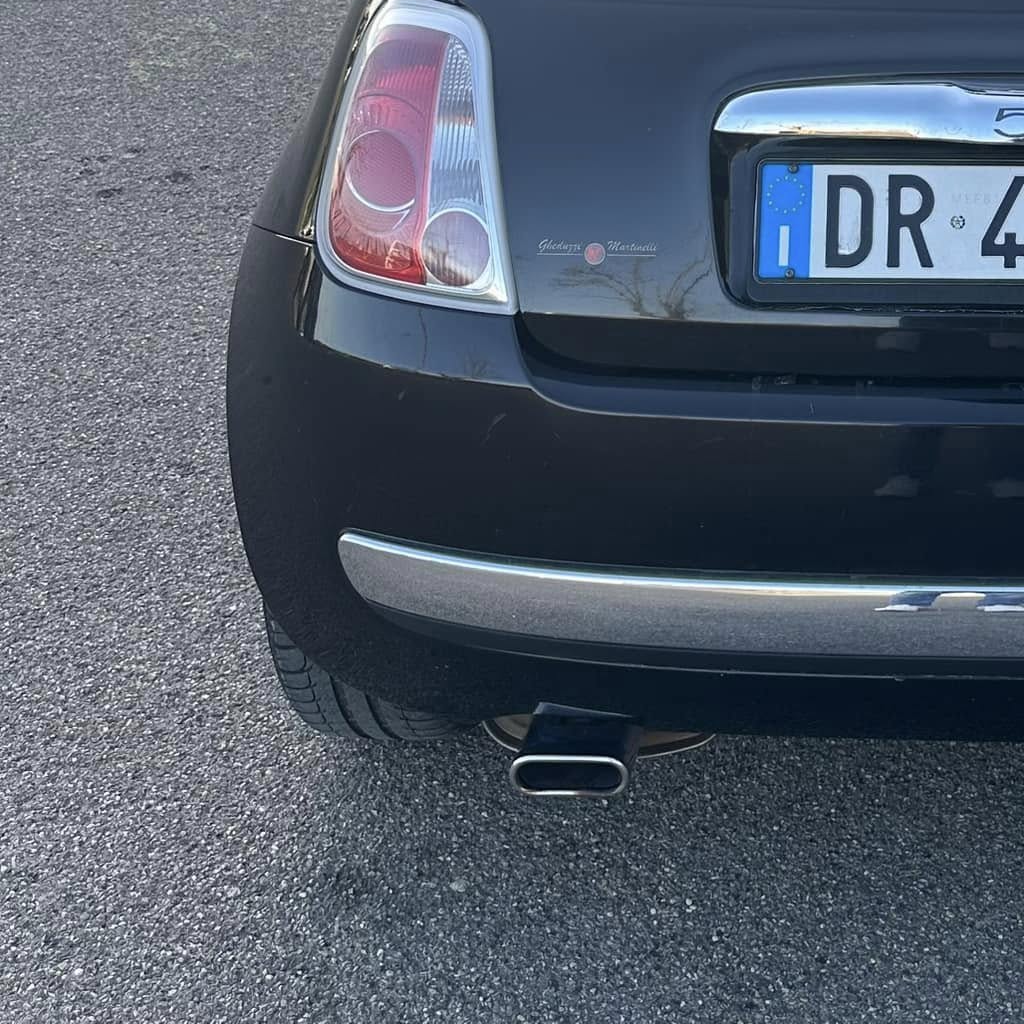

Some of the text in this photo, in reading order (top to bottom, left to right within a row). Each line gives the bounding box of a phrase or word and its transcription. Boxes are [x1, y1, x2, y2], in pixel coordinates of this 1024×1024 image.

[607, 240, 657, 252] Martinelli
[778, 225, 790, 267] I
[825, 174, 935, 269] DR
